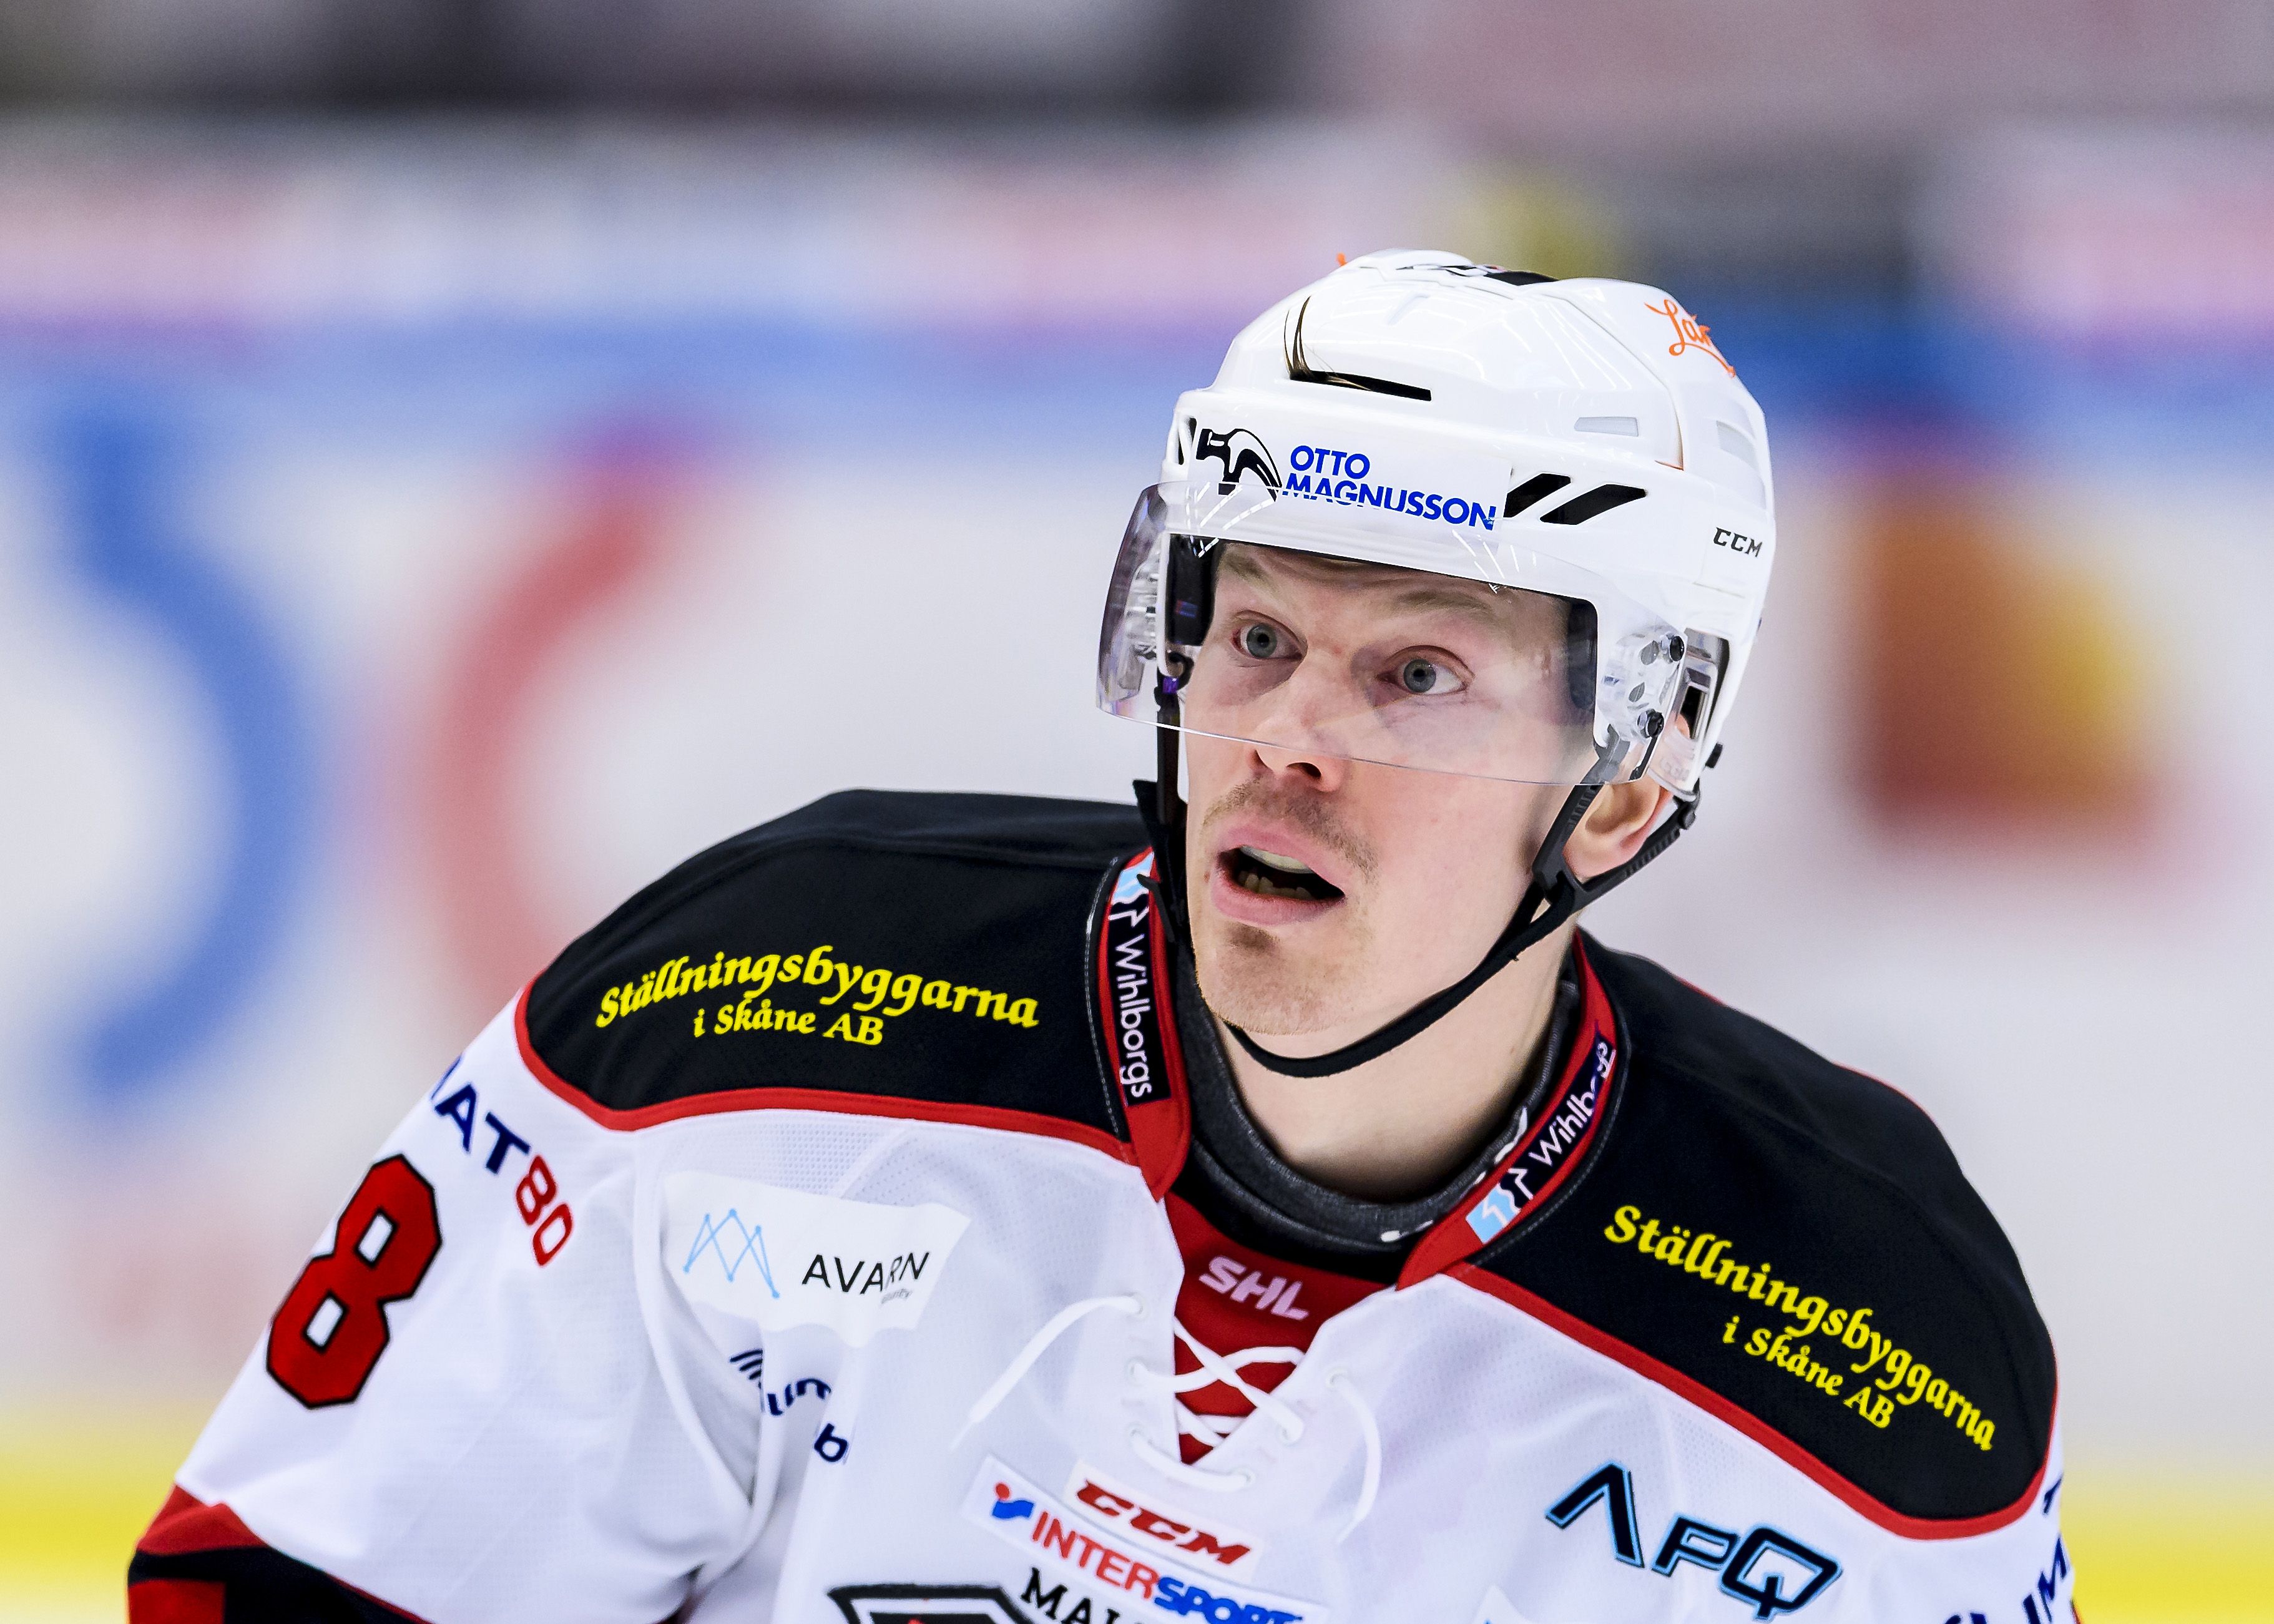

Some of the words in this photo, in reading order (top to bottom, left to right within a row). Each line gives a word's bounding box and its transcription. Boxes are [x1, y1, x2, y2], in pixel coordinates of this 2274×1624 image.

[1282, 472, 1496, 531] MAGNUSSON
[1290, 445, 1370, 479] OTTO
[1713, 527, 1763, 557] CCM
[595, 945, 1039, 1029] Ställningsbyggarna
[693, 1009, 705, 1037] i
[713, 999, 816, 1035] Skåne
[823, 1015, 884, 1045] AB
[1115, 934, 1153, 1098] Wihlborgs
[429, 1055, 574, 1267] AT80
[265, 1153, 443, 1411] 8
[801, 1252, 929, 1294] AVARN
[1198, 1256, 1309, 1320] SHL
[1604, 1205, 1996, 1451] Ställningsbyggarna
[1722, 1316, 1740, 1344] i
[1744, 1328, 1843, 1396] Skåne
[1843, 1386, 1902, 1429] AB
[1076, 1480, 1250, 1565] CCM
